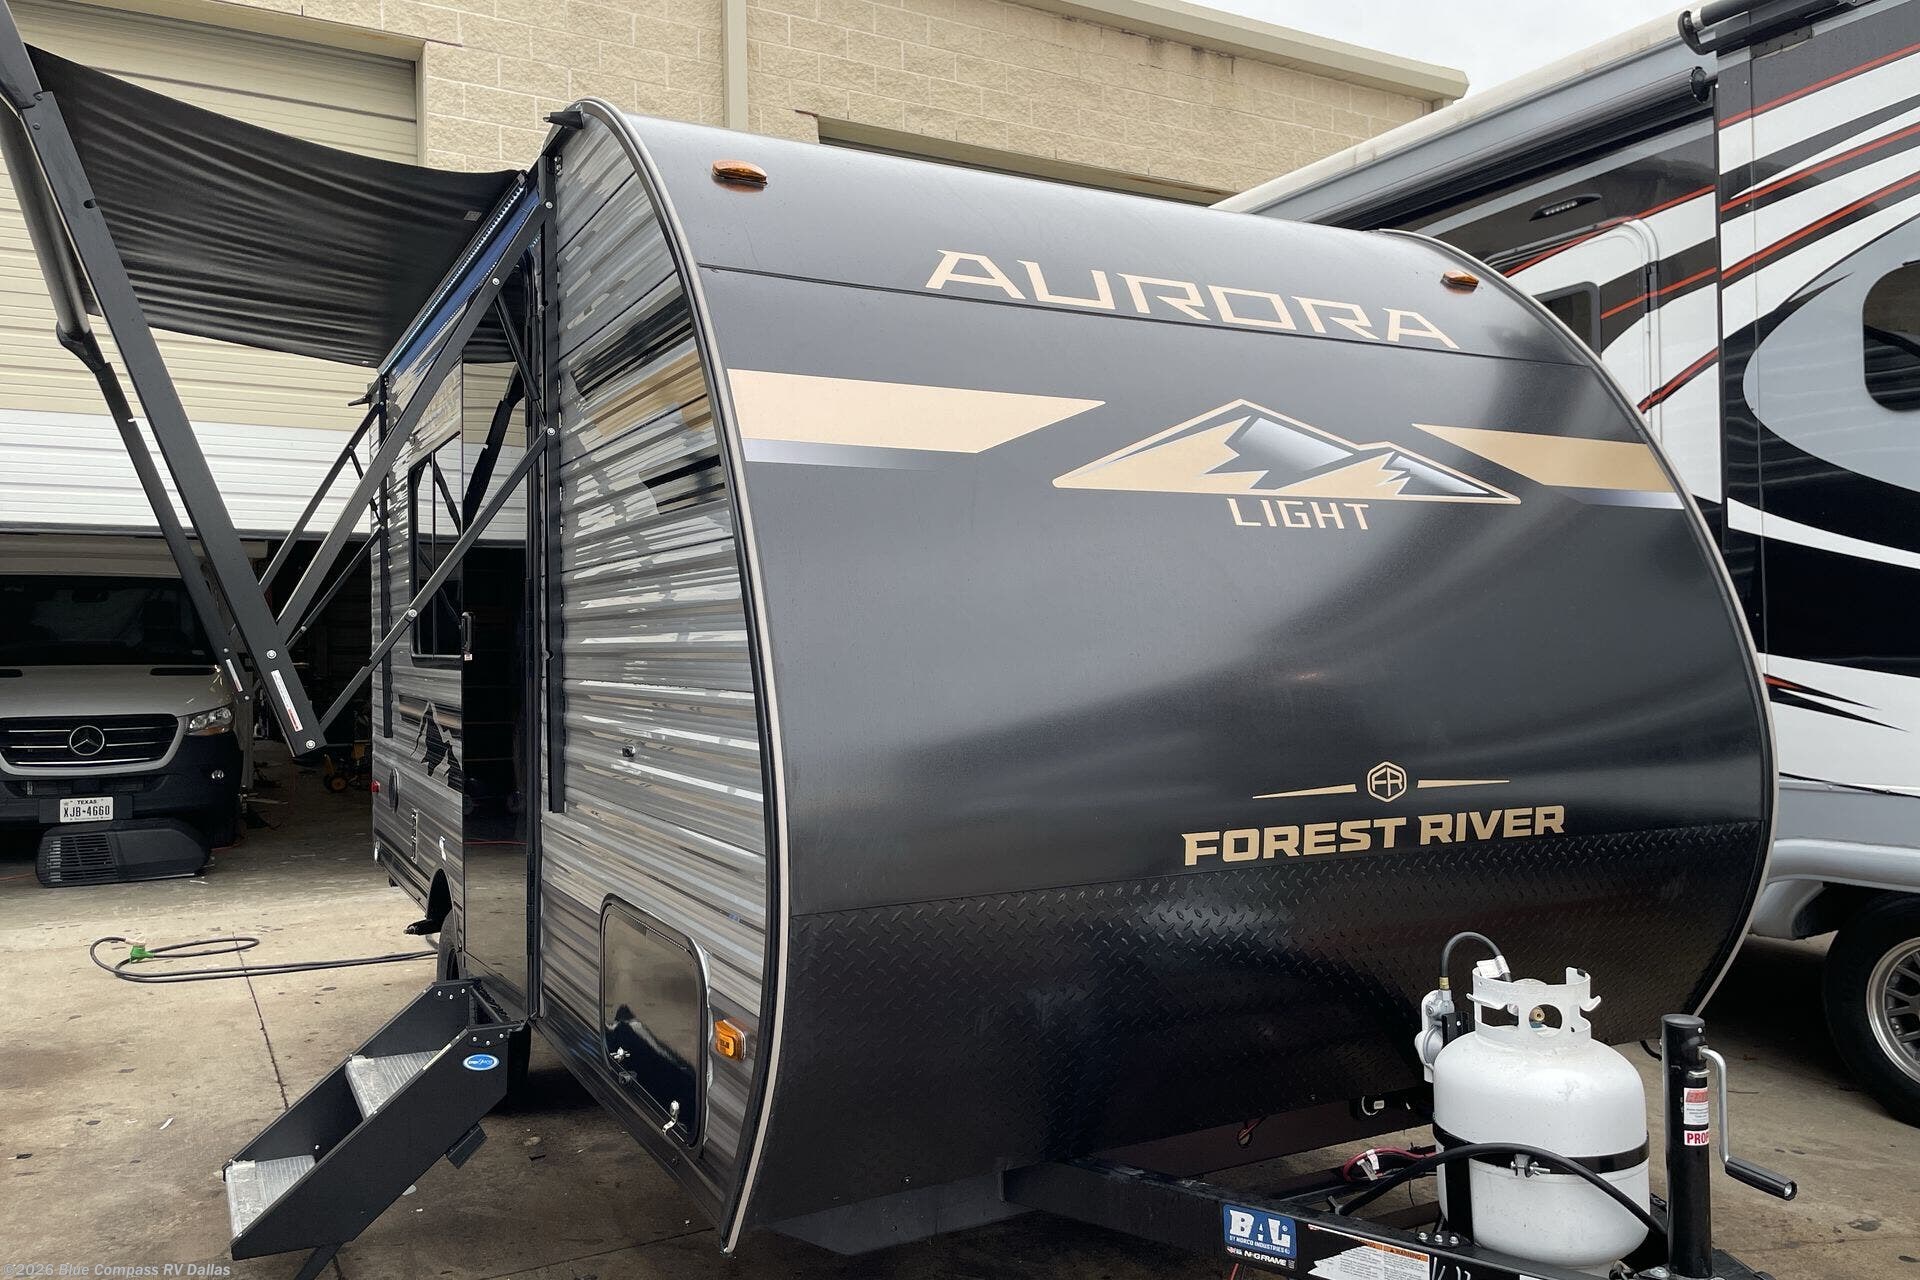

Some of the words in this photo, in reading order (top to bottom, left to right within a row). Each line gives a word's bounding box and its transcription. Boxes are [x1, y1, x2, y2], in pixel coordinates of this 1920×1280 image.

[925, 249, 1460, 349] AURORA
[1227, 498, 1369, 530] LIGHT
[1181, 817, 1406, 866] FOREST
[1418, 805, 1565, 845] RIVER
